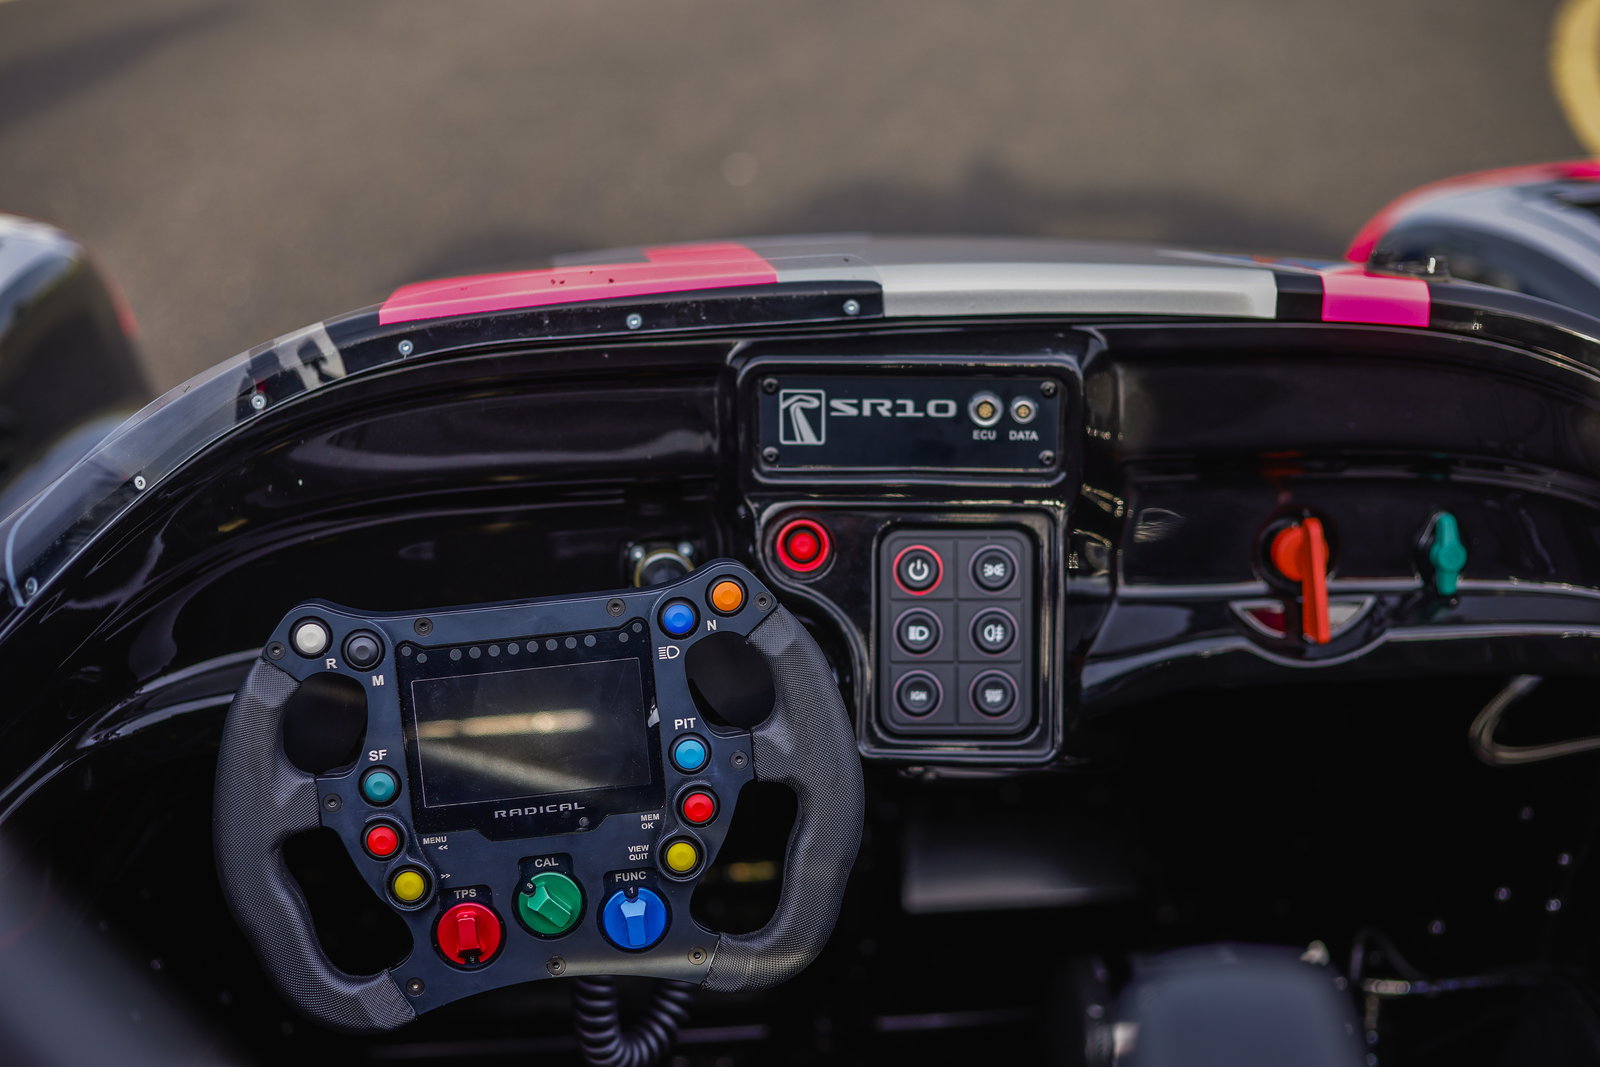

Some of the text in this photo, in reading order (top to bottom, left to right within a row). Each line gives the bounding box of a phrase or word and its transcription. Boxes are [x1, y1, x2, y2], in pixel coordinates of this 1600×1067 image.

[830, 399, 957, 417] SR10
[972, 430, 997, 441] ECU
[1008, 430, 1039, 441] DATA
[707, 619, 717, 631] N
[326, 658, 338, 670] R
[371, 674, 385, 687] M
[910, 691, 927, 700] IGN
[674, 717, 696, 730] PIT
[368, 749, 387, 762] SF
[494, 802, 585, 819] RADICAL
[640, 813, 660, 822] MEM
[641, 822, 654, 830] OK
[422, 835, 447, 845] MENU
[628, 844, 649, 853] VIEW
[534, 857, 559, 868] CAL
[629, 853, 649, 861] QUIT
[615, 870, 647, 883] FUNC
[453, 888, 477, 899] TPS
